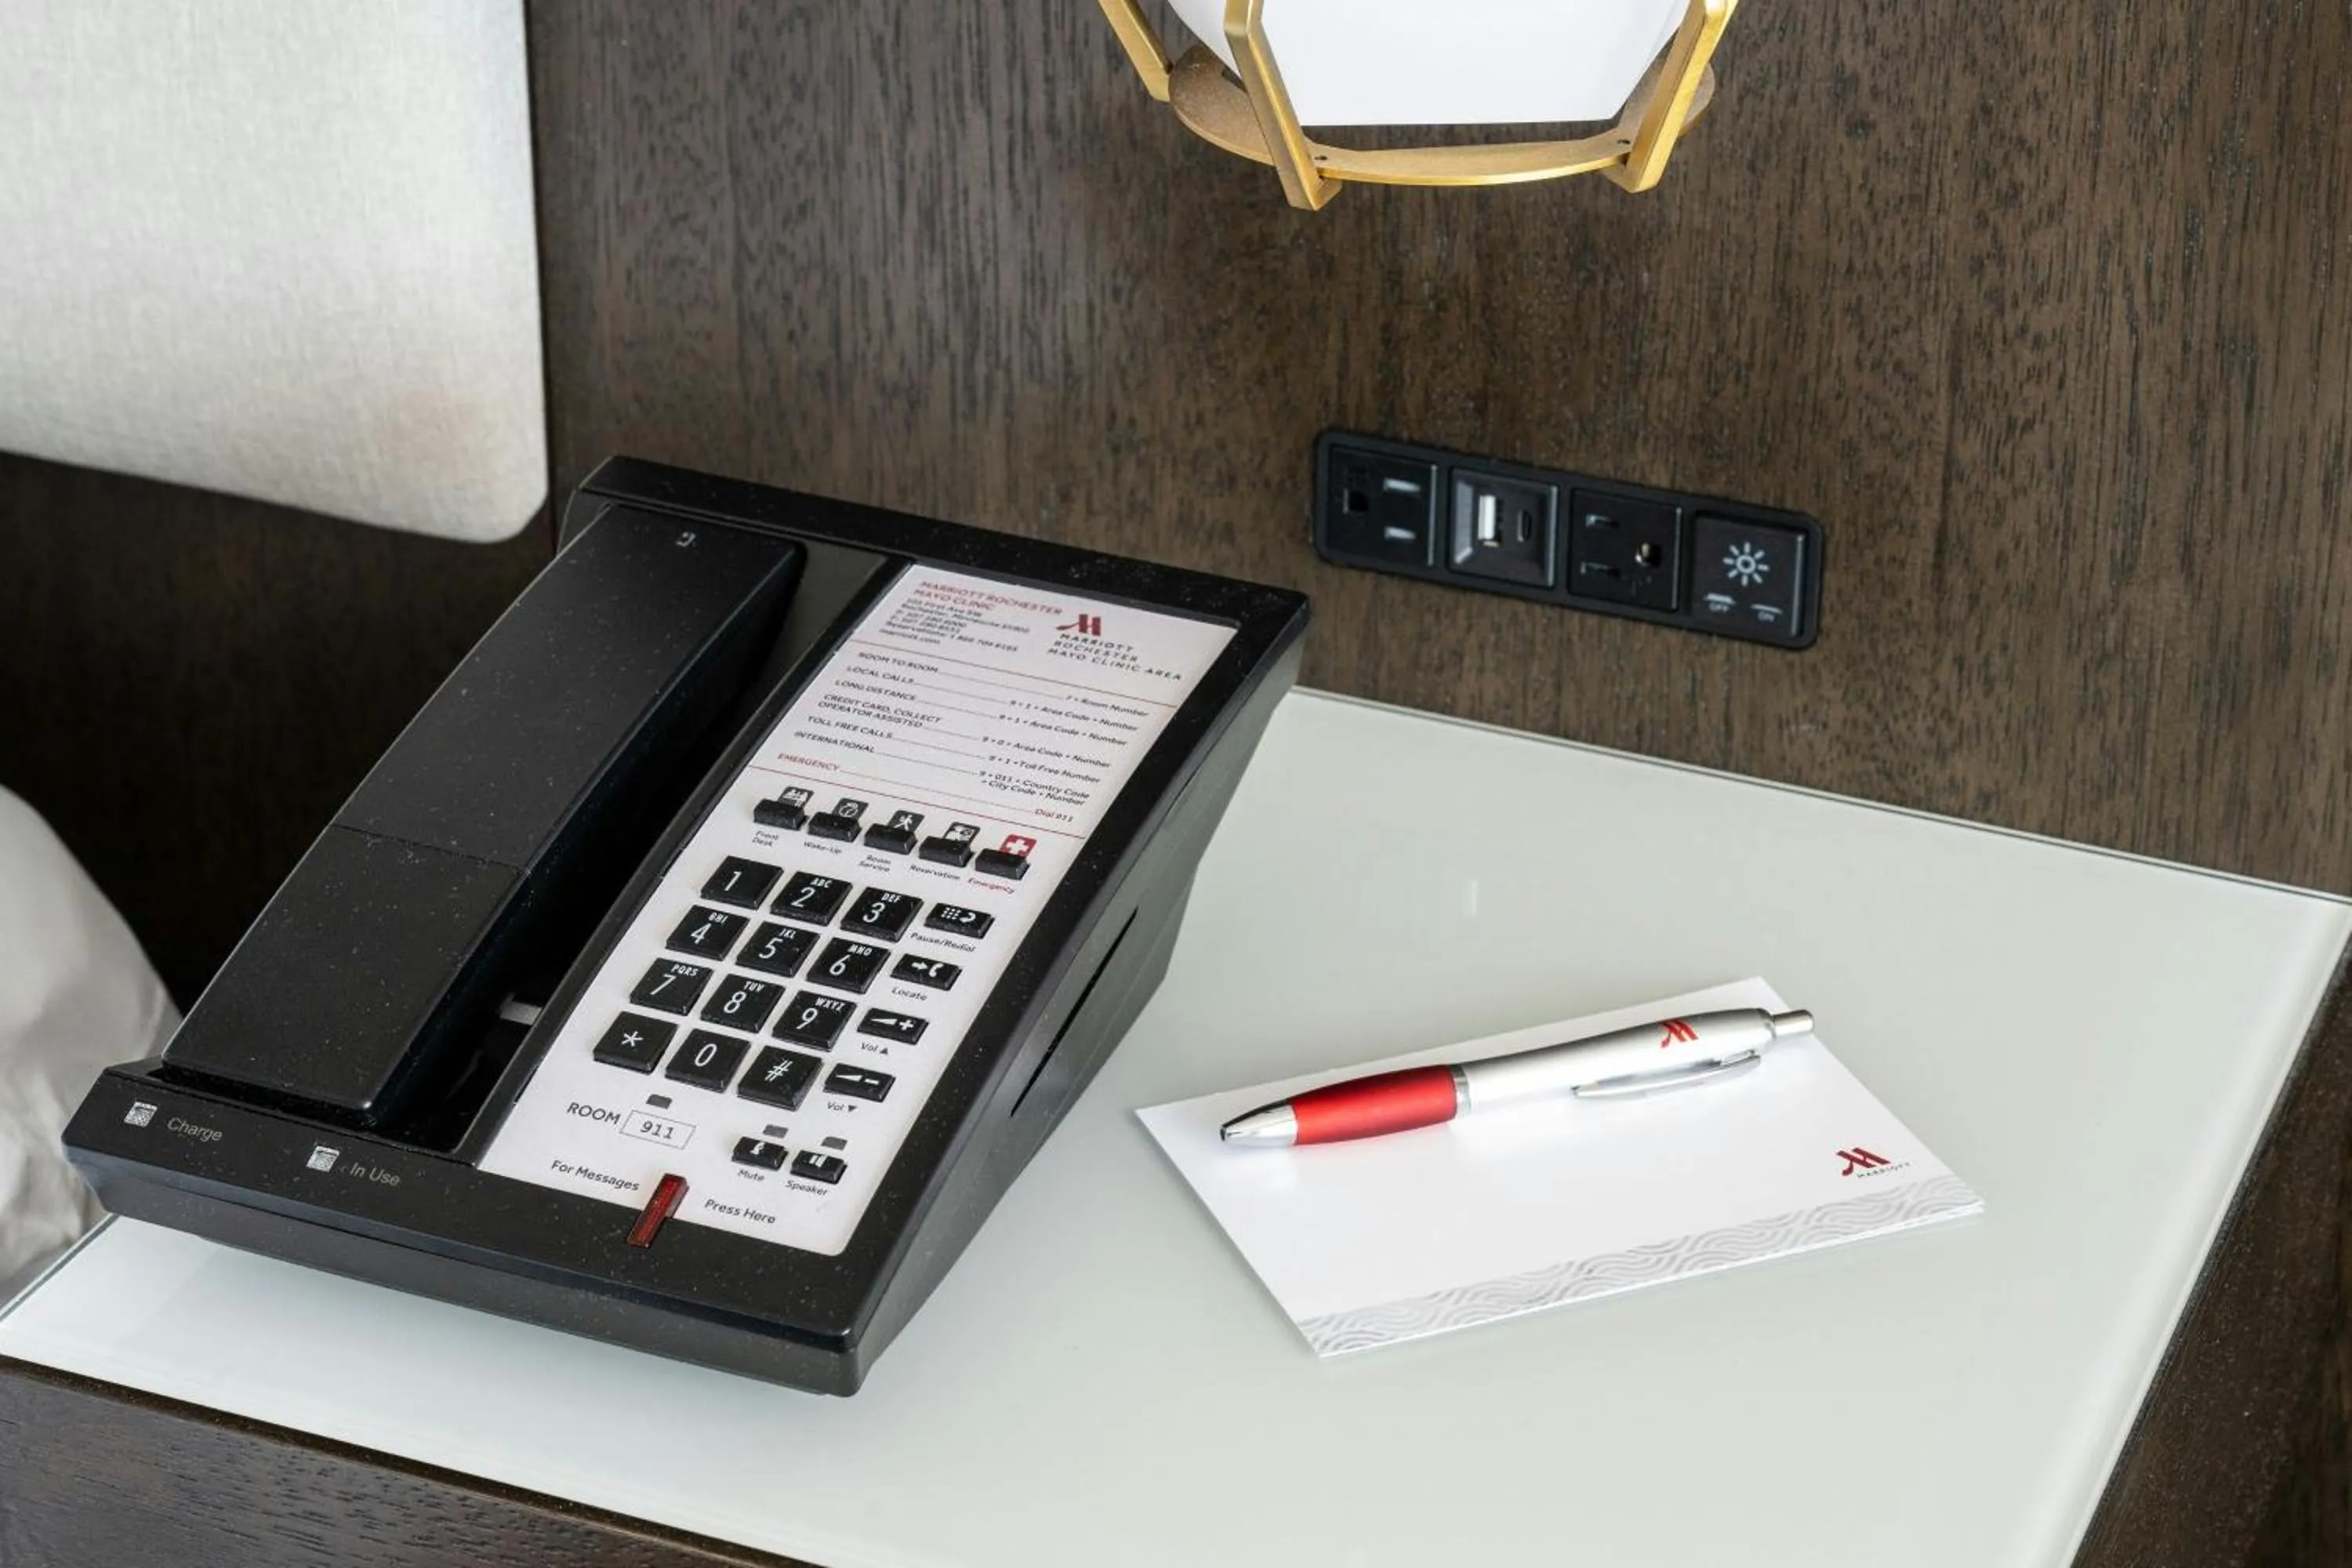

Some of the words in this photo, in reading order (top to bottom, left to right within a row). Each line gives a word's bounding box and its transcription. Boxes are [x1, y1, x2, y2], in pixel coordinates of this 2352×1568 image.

[913, 589, 951, 601] MAYO
[953, 597, 994, 610] CLINIC
[920, 581, 985, 599] MARRIOTT
[985, 595, 1062, 615] ROCHESTER
[1709, 601, 1730, 612] OFF
[1757, 611, 1774, 622] ON
[1054, 641, 1138, 662] ROCHESTER
[1059, 633, 1133, 652] MARRIOTT
[1047, 648, 1086, 660] MAYO
[1091, 657, 1140, 672] CLINIC
[1145, 668, 1181, 681] AREA
[858, 652, 890, 663] ROOM
[907, 662, 938, 673] ROOM
[1080, 699, 1109, 709] Room
[1109, 704, 1149, 717] Number
[824, 694, 862, 706] CREDIT
[893, 708, 941, 723] COLLECT
[847, 666, 879, 677] LOCAL
[882, 673, 914, 684] CALLS
[1040, 706, 1063, 716] Area
[1064, 711, 1091, 721] Code
[1098, 718, 1138, 731] Number
[835, 680, 864, 691] LONG
[866, 685, 915, 701] DISTANCE
[1029, 720, 1053, 730] Area
[1054, 725, 1080, 735] Code
[1088, 733, 1127, 746] Number
[818, 701, 873, 717] OPERATOR
[873, 713, 923, 728] ASSISTED
[1013, 742, 1036, 752] Area
[1037, 747, 1063, 758] Code
[1072, 755, 1111, 768] Number
[808, 716, 831, 727] TOLL
[835, 721, 858, 731] FREE
[860, 727, 892, 739] CALLS
[1037, 764, 1060, 775] Free
[1061, 769, 1100, 783] Number
[794, 731, 874, 753] INTERNATIONAL
[1022, 779, 1062, 794] Country
[1064, 788, 1090, 799] Code
[777, 753, 839, 771] EMERGENCY
[1034, 808, 1055, 818] Dial
[1054, 813, 1073, 822] 911
[989, 780, 1010, 791] City
[1011, 785, 1036, 796] Code
[1045, 793, 1085, 806] Number
[752, 837, 772, 847] Desk
[755, 830, 779, 840] Front
[804, 841, 842, 854] Wake-Up
[858, 860, 891, 873] Service
[866, 855, 891, 865] Room
[724, 871, 741, 891] 1
[909, 864, 960, 880] Reservation
[811, 878, 831, 888] ABC
[967, 877, 1015, 895] Emergency
[791, 887, 815, 907] 2
[881, 893, 901, 902] DEF
[709, 912, 728, 924] GHI
[863, 902, 885, 923] 3
[691, 923, 711, 944] 4
[779, 928, 796, 938] JKL
[910, 932, 976, 953] Pause/Redial
[759, 937, 783, 959] 5
[848, 944, 872, 956] MNO
[670, 964, 699, 977] PQRS
[829, 954, 851, 975] 6
[650, 974, 677, 995] 7
[744, 981, 764, 992] TUV
[891, 987, 927, 1001] Locate
[724, 991, 746, 1014] 8
[815, 997, 845, 1011] WXYZ
[796, 1007, 818, 1029] 9
[695, 1044, 717, 1067] 0
[861, 1042, 879, 1053] Vol
[764, 1060, 793, 1082] #
[827, 1102, 845, 1111] Vol
[166, 1116, 223, 1142] Charge
[567, 1102, 621, 1125] ROOM
[640, 1120, 674, 1140] 911
[350, 1162, 365, 1177] In
[368, 1166, 400, 1186] Use
[551, 1160, 575, 1174] For
[575, 1166, 641, 1191] Messages
[738, 1169, 764, 1181] Mute
[1856, 1162, 1911, 1178] MARRIOTT
[785, 1180, 828, 1196] Speaker
[704, 1199, 741, 1216] Press
[742, 1208, 776, 1224] Here
